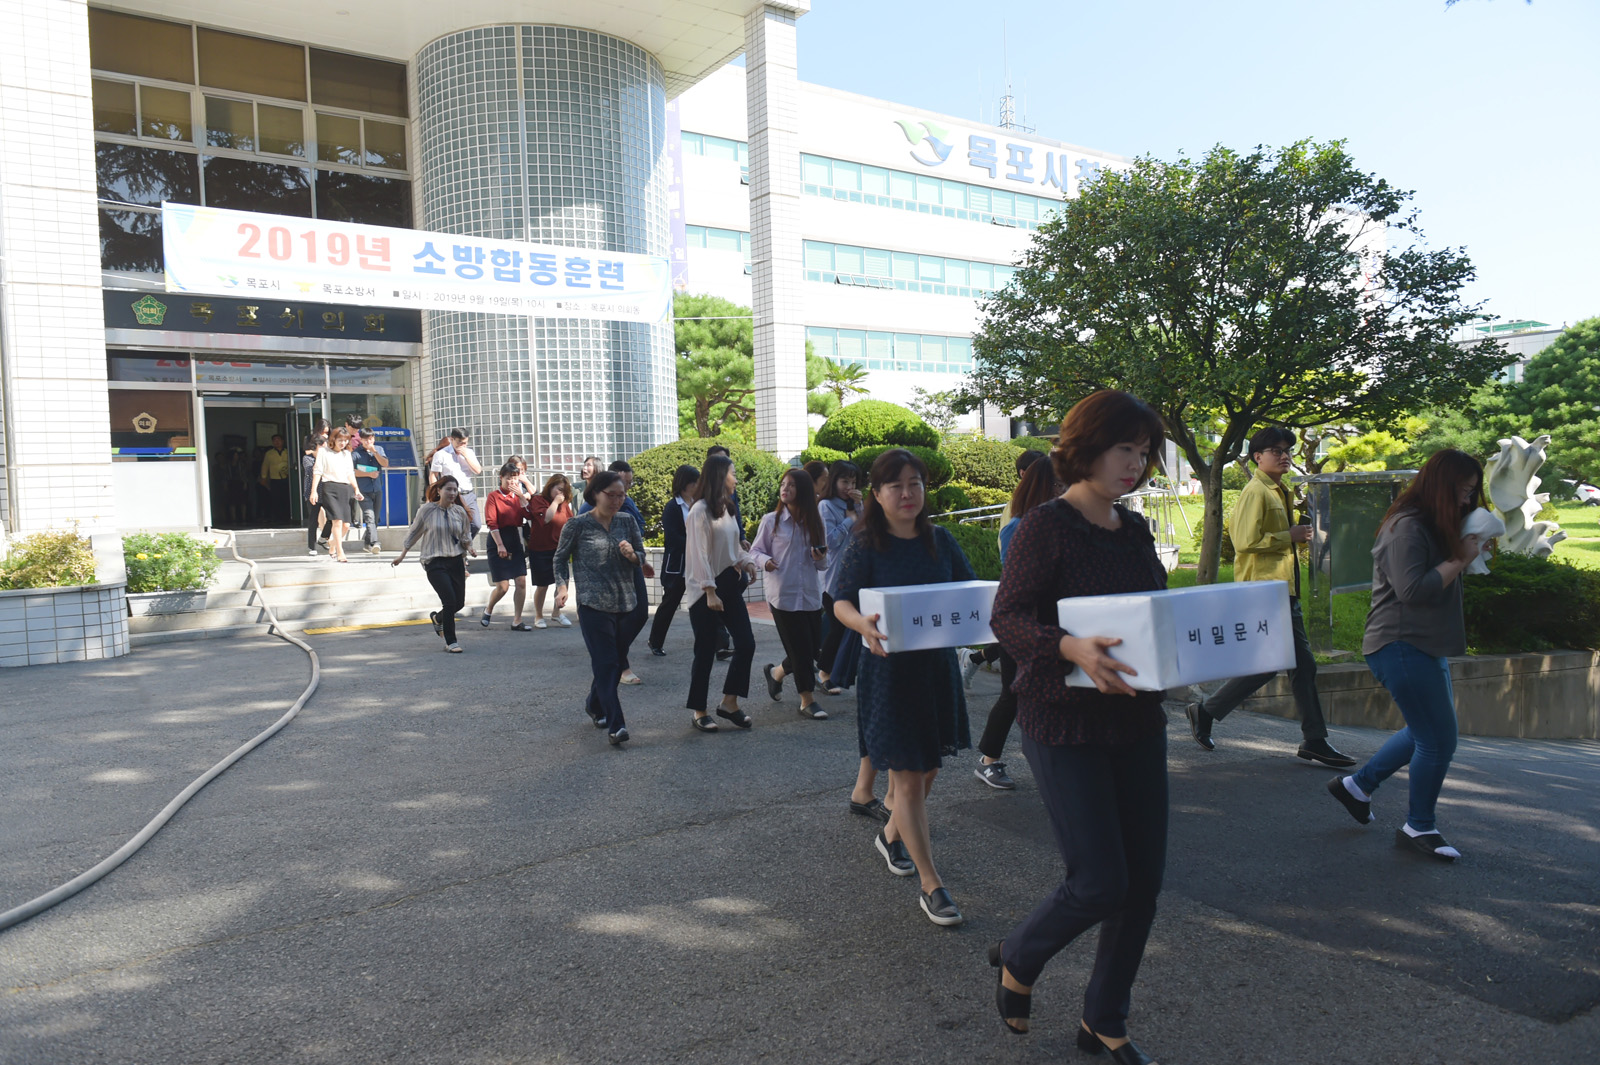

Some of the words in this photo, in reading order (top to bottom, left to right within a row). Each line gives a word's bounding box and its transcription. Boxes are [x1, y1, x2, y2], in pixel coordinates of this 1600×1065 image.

[237, 223, 391, 271] 2019년
[413, 242, 625, 290] 소방합동훈련
[246, 278, 280, 290] 목포시
[323, 284, 375, 297] 목포소방서
[402, 290, 421, 300] 일시
[434, 292, 466, 304] 2019년
[470, 295, 485, 305] 9월
[489, 297, 523, 307] 19일(목)
[527, 299, 545, 308] 10시
[564, 302, 580, 311] 장소
